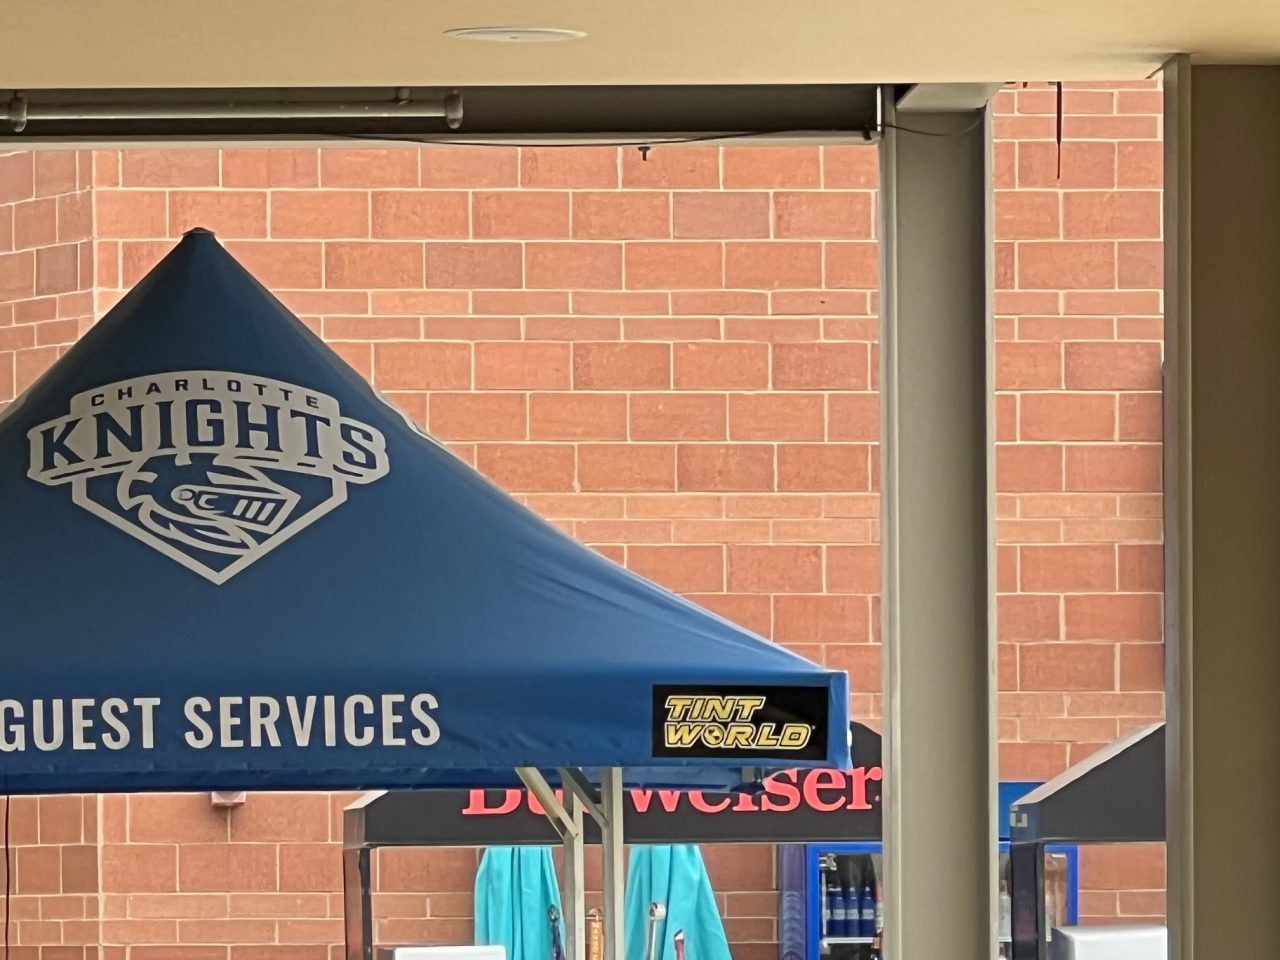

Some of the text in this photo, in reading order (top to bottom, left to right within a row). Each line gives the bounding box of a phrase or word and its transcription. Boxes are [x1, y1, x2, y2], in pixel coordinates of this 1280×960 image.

[91, 378, 320, 408] CHARLOTTE
[39, 398, 378, 473] KNIGHTS
[183, 692, 442, 750] SERVICES
[665, 695, 766, 722] TINT
[665, 721, 812, 750] WORLD
